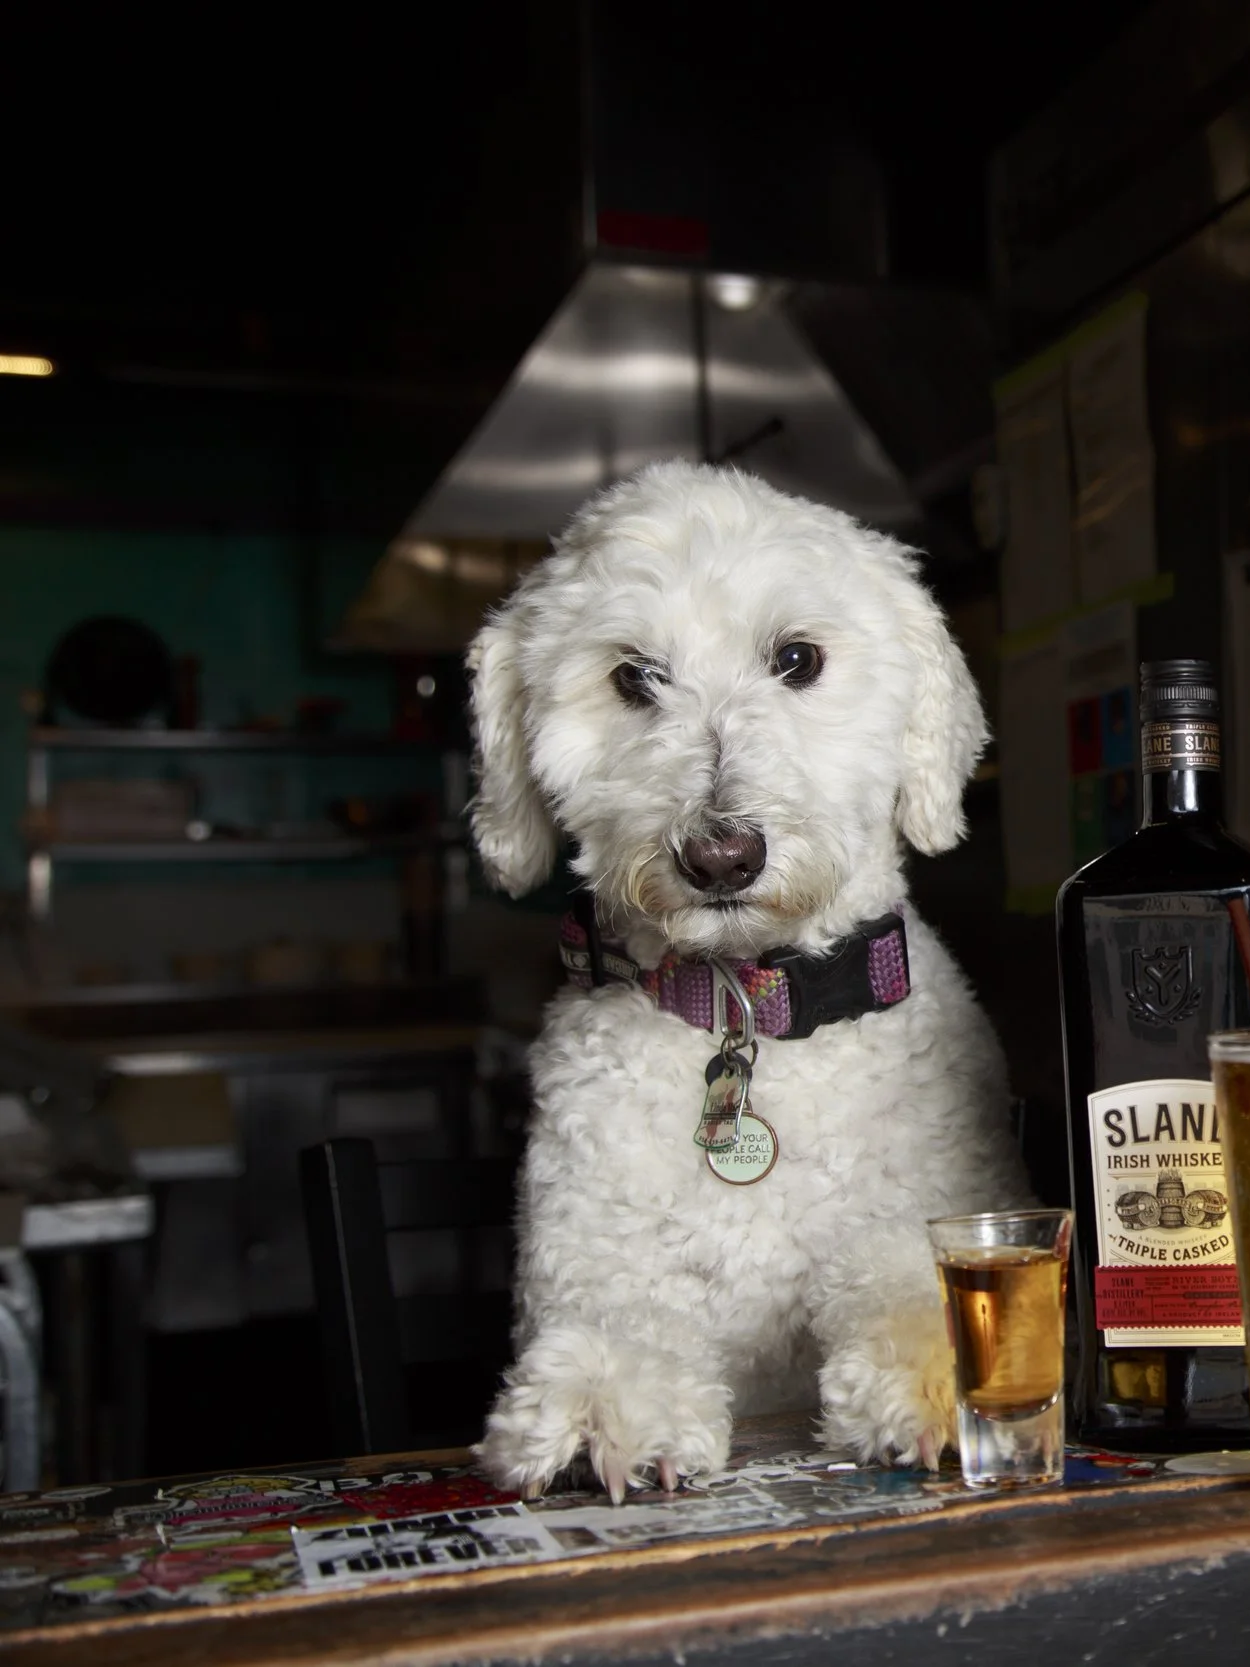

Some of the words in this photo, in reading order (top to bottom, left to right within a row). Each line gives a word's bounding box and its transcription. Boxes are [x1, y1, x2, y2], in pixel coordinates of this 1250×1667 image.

[743, 1134, 768, 1142] YOUR
[711, 1145, 745, 1154] EOPLE
[748, 1144, 770, 1153] CALL
[717, 1157, 730, 1165] MY
[734, 1155, 768, 1164] PEOPLE
[1107, 1154, 1150, 1169] IRISH
[1118, 1235, 1167, 1261] TRIPLE
[1173, 1234, 1229, 1261] CASKED
[1102, 1289, 1144, 1300] DISTILLERY
